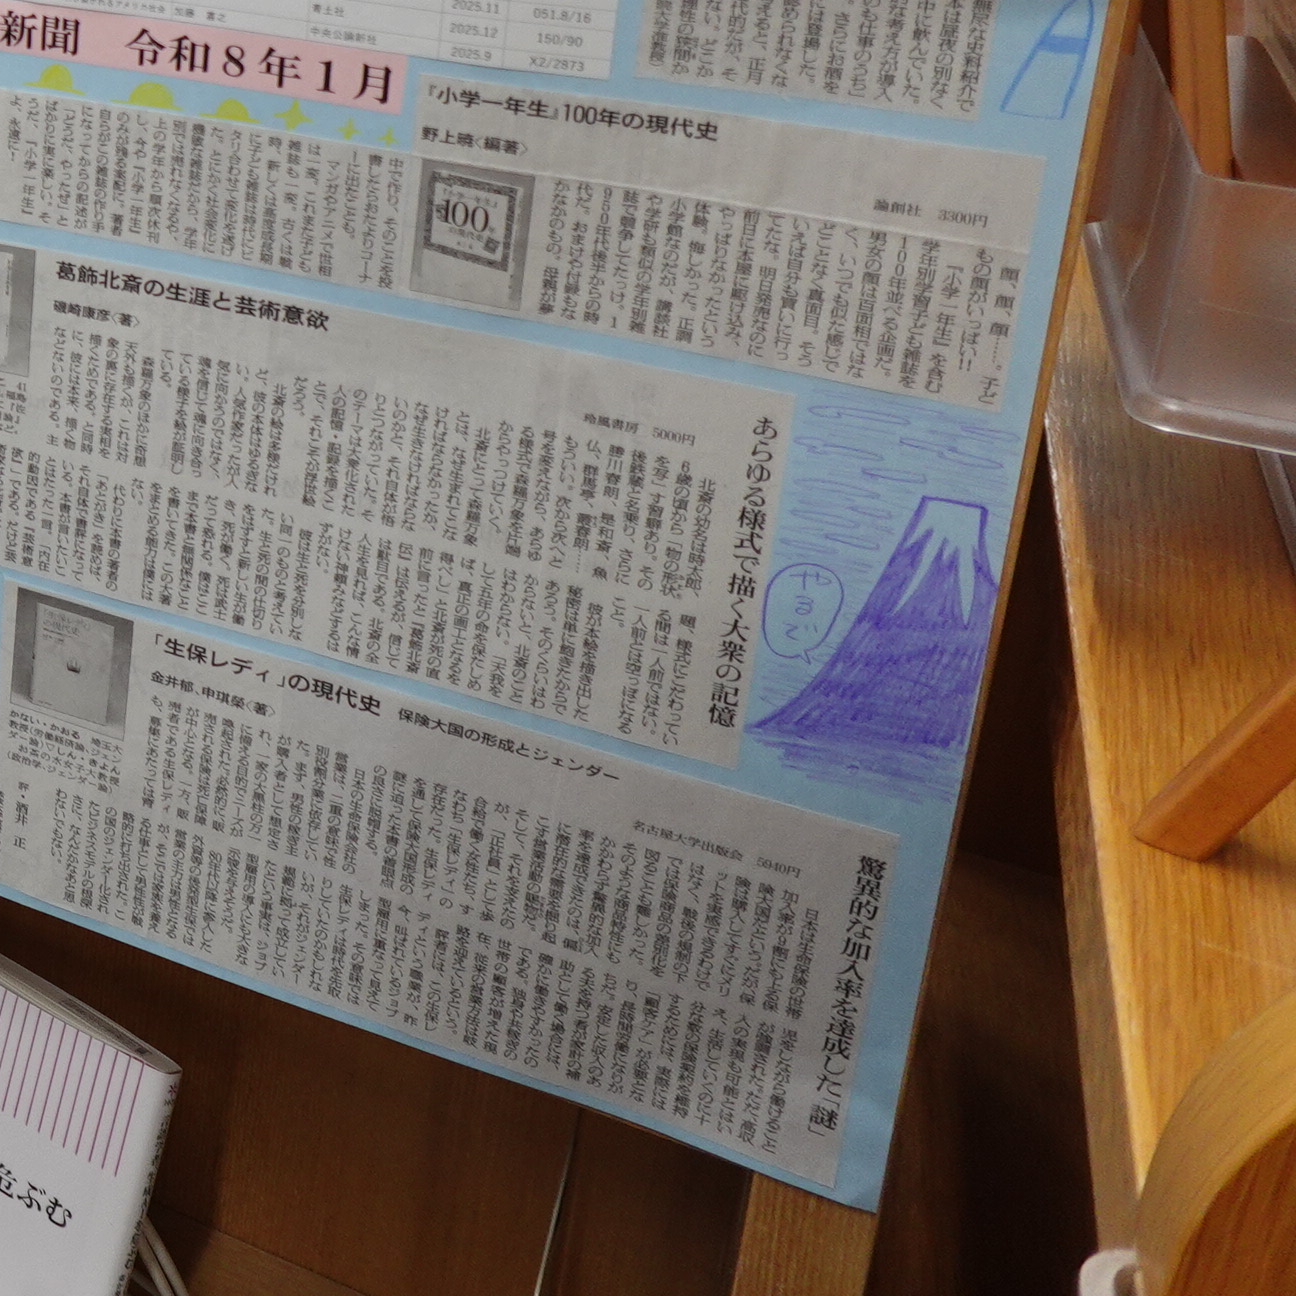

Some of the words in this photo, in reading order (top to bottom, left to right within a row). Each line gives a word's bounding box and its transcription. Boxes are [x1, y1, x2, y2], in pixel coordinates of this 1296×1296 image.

[122, 26, 393, 106] 令和8年1月
[426, 86, 719, 143] 『小学一年生』100年の現代史
[55, 260, 331, 332] 葛飾北斎の生涯と芸術意欲
[708, 415, 779, 730] あらゆる様式で描く大衆の記憶
[153, 632, 382, 717] 「生保レディ」の現代史
[398, 706, 621, 782] 保険大国の形成とジェンダー
[807, 853, 888, 1138] 驚異的な加入率を達成した「謎」
